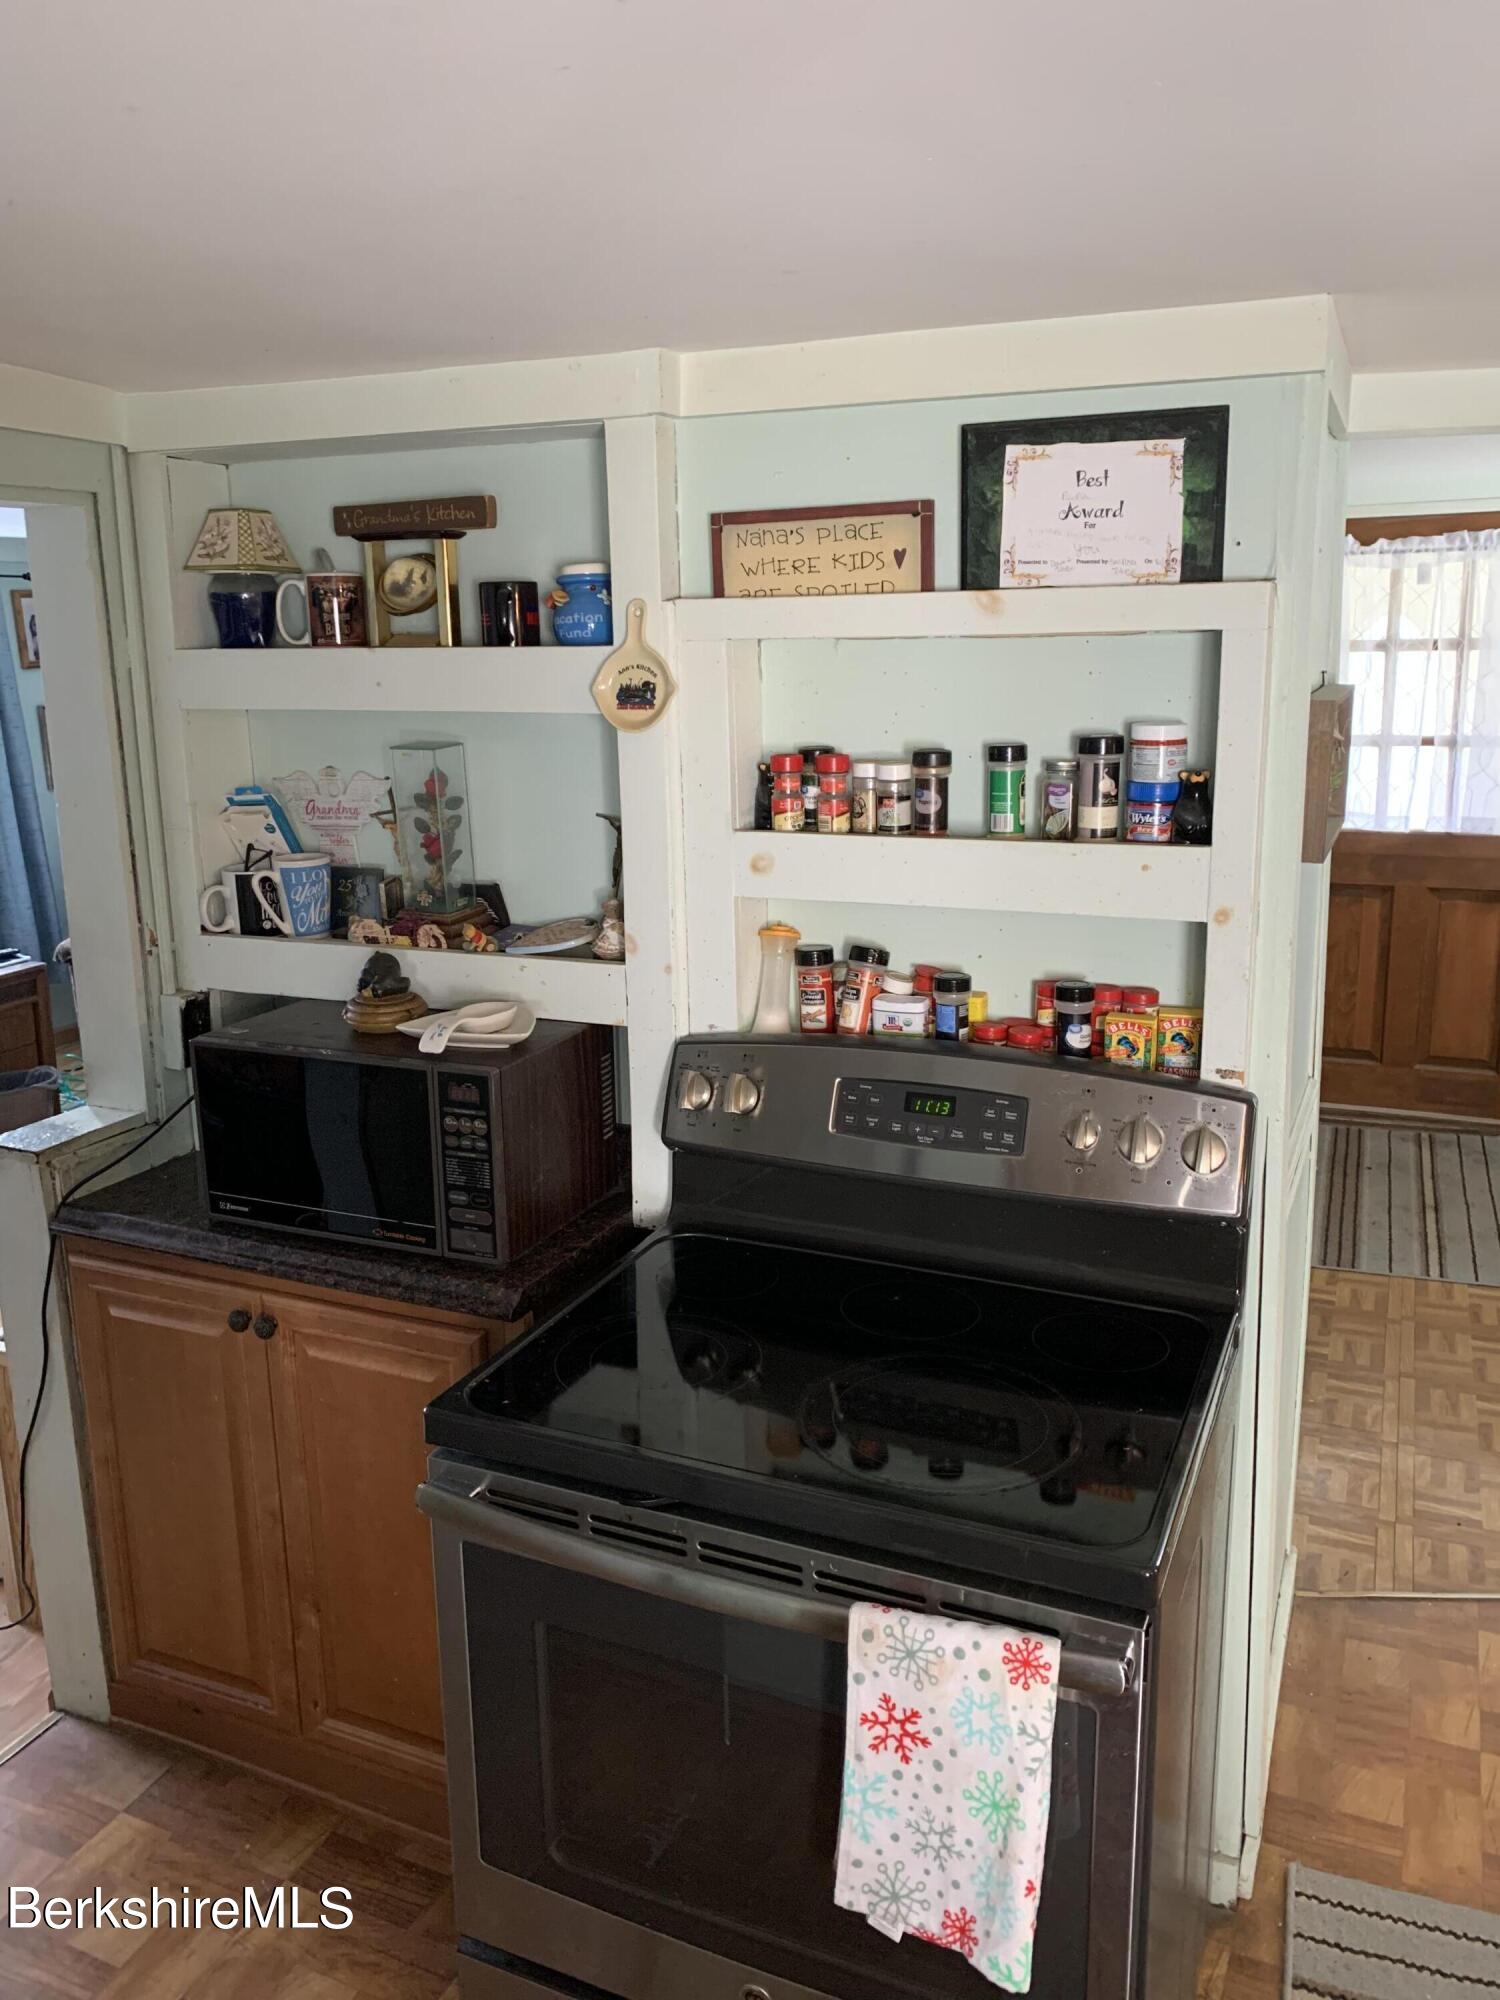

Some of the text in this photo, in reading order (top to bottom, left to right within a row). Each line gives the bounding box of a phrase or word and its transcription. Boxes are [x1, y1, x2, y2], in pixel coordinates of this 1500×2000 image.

[1076, 469, 1110, 488] Best
[426, 503, 476, 524] Kitchen
[1058, 499, 1125, 521] Award
[1083, 521, 1097, 529] For
[740, 550, 886, 578] WHERE KIDS
[555, 612, 604, 625] acation
[305, 799, 361, 821] Grandma
[1158, 1066, 1200, 1078] SEASONIN
